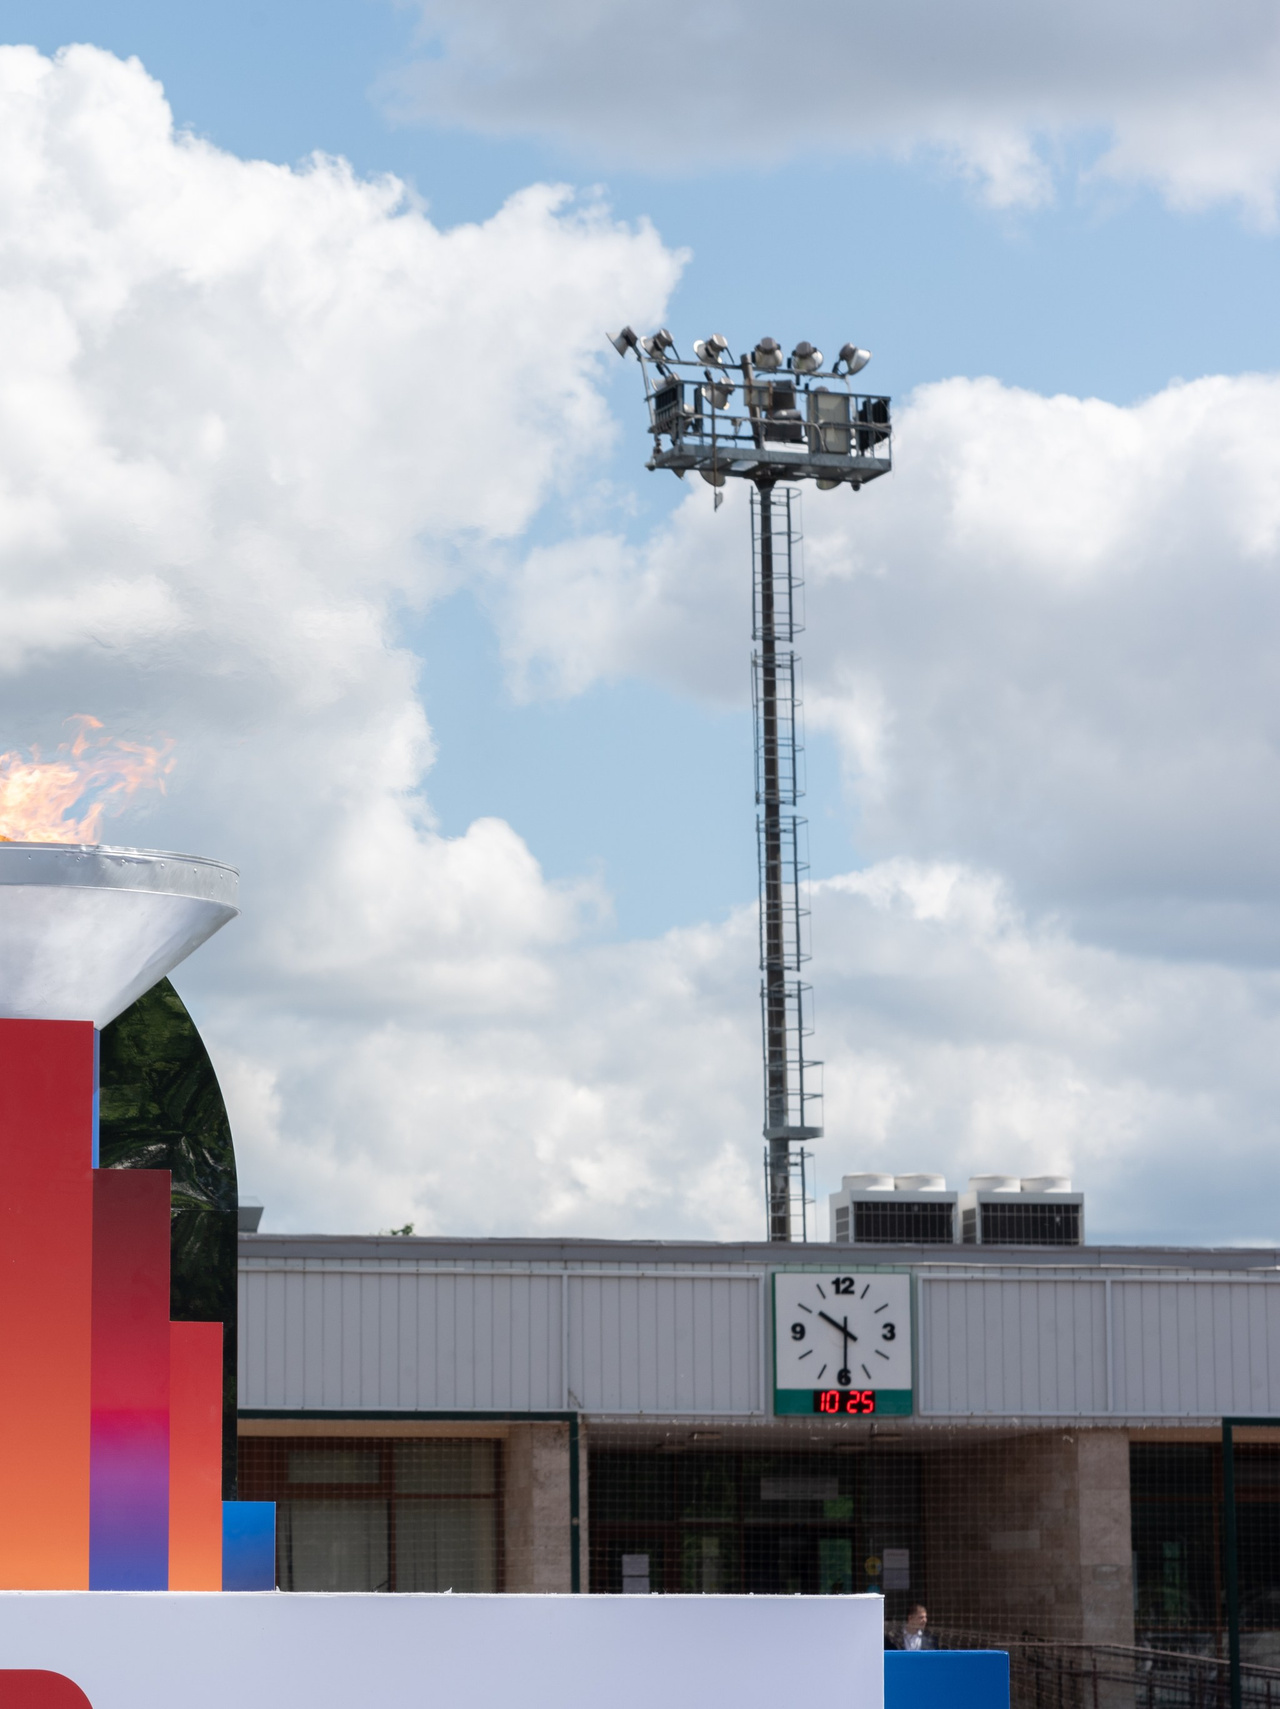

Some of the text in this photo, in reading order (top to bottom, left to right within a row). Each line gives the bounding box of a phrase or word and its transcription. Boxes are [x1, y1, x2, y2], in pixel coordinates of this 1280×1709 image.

[831, 1277, 855, 1295] 12
[791, 1322, 806, 1341] 9
[882, 1322, 896, 1341] 3
[837, 1368, 852, 1386] 6
